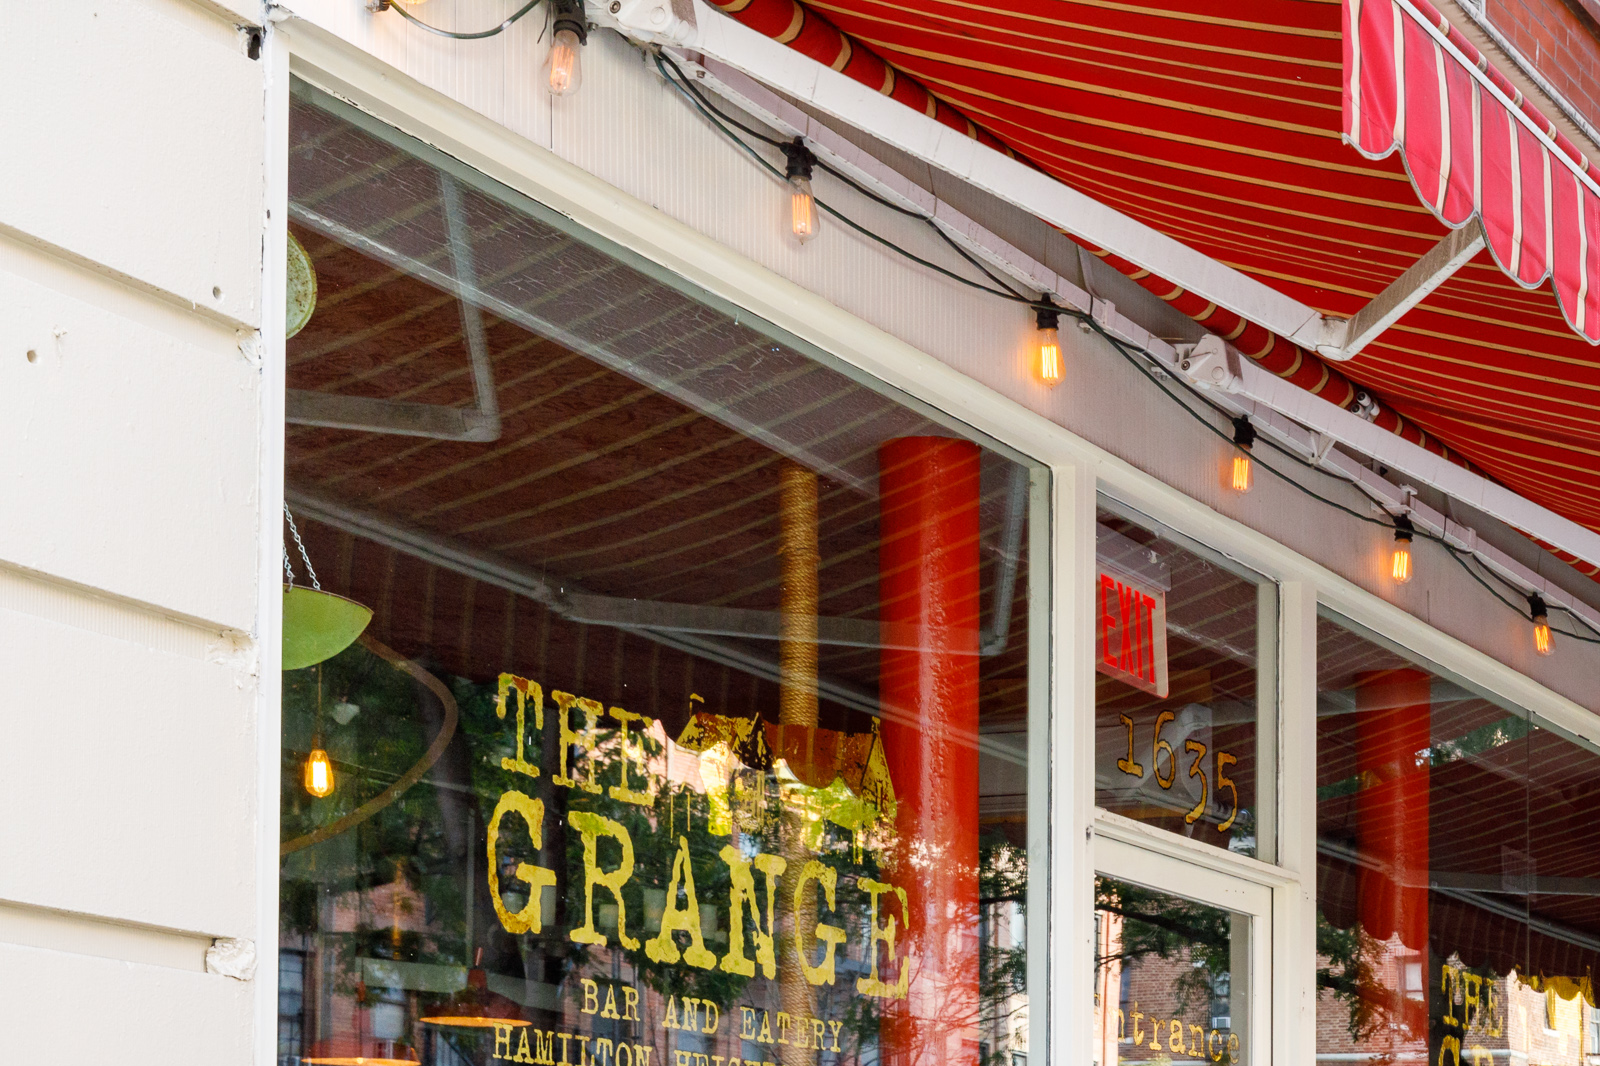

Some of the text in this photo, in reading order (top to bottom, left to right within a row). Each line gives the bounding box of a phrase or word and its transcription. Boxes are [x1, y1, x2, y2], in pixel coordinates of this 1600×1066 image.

[1101, 572, 1156, 684] EXIT
[497, 673, 661, 806] THE
[1117, 710, 1237, 832] 1635
[487, 790, 910, 1000] GRANGE
[580, 978, 843, 1052] BAR AND EATERY
[1106, 1000, 1240, 1064] ntrance
